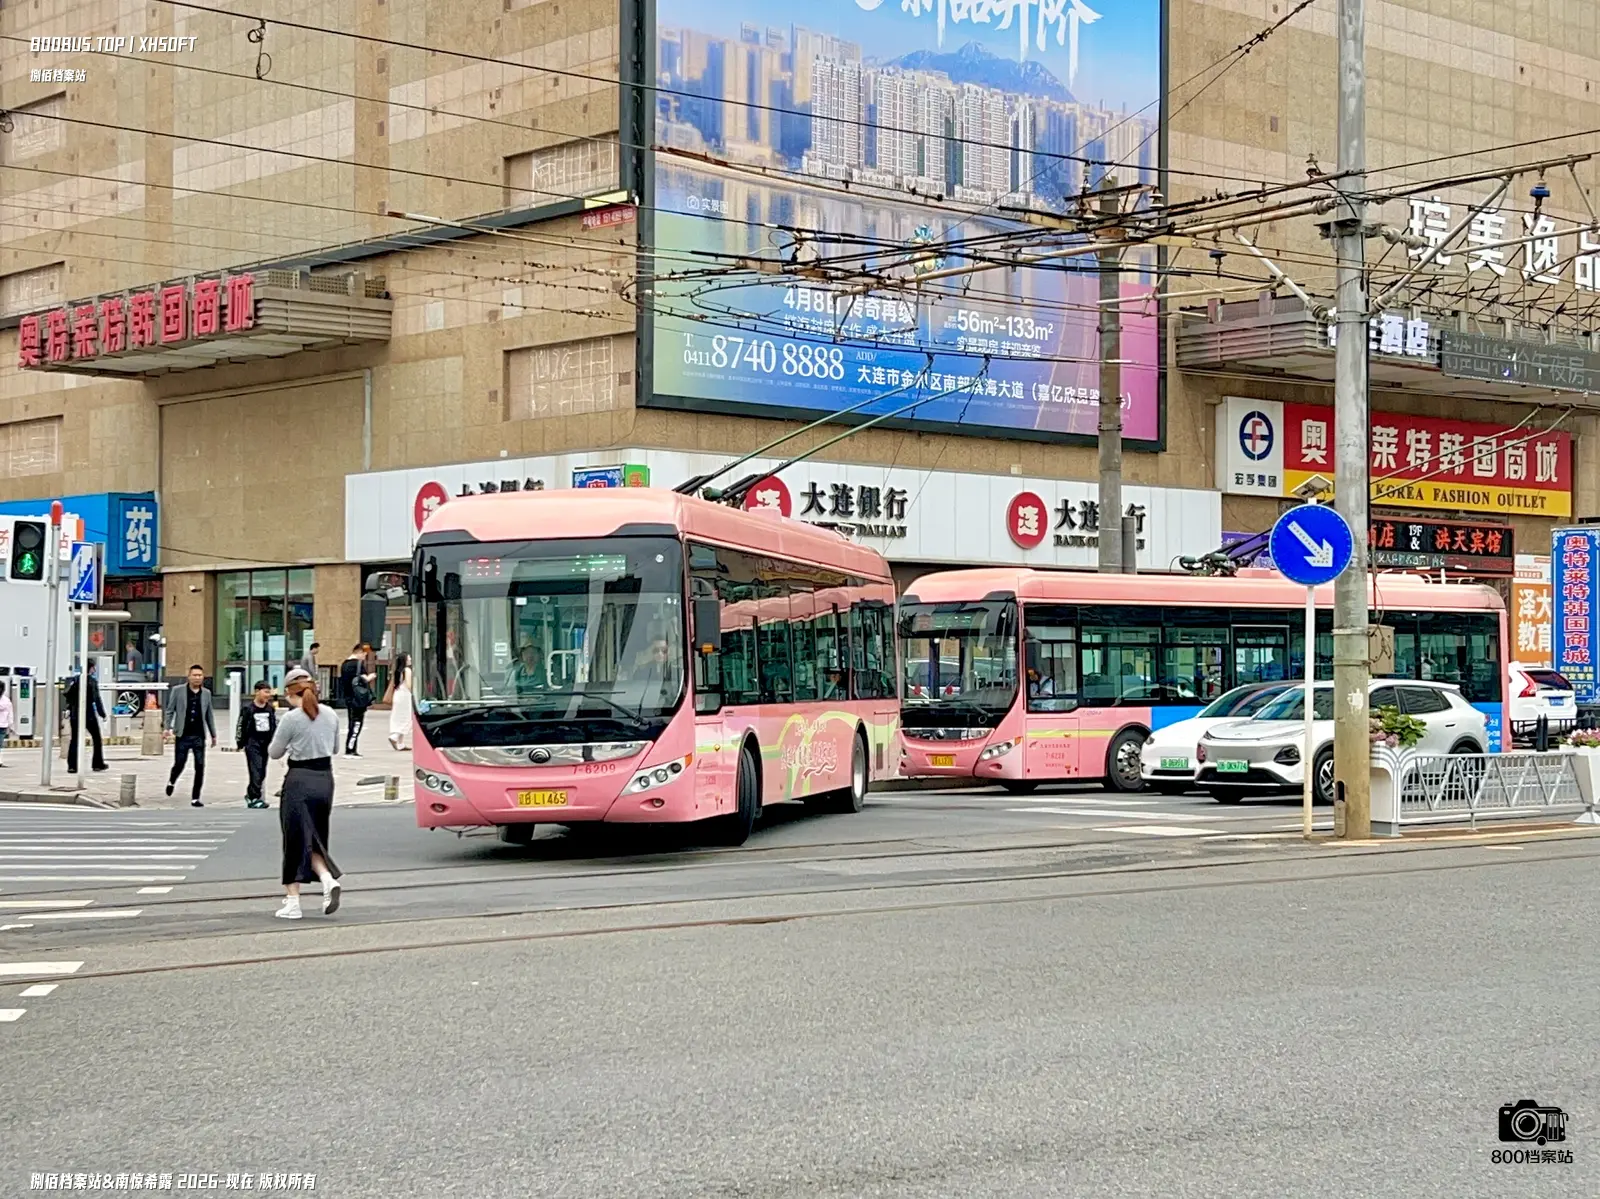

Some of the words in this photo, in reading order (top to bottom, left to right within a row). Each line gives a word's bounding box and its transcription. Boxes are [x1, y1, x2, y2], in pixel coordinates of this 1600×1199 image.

[701, 198, 729, 214] 实景图
[783, 287, 841, 315] 4月8日
[18, 271, 257, 368] 奥特莱特韩国商城
[782, 342, 845, 380] 8888
[856, 351, 878, 362] ADD/
[1300, 418, 1559, 484] 奥莱特韩国商城
[801, 481, 908, 521] 大连银行
[1375, 483, 1424, 501] KOREA
[1433, 487, 1491, 505] FASHION
[1497, 493, 1547, 509] OUTLET
[855, 523, 907, 537] DALIAN
[1054, 498, 1146, 533] 大连行
[125, 505, 153, 563] 药
[1053, 534, 1085, 548] BANK
[1435, 527, 1503, 555] 洪天宾馆
[1563, 536, 1590, 663] 奥特莱特韩国商城
[1518, 621, 1551, 652] 教育
[572, 764, 616, 775] 7-6209
